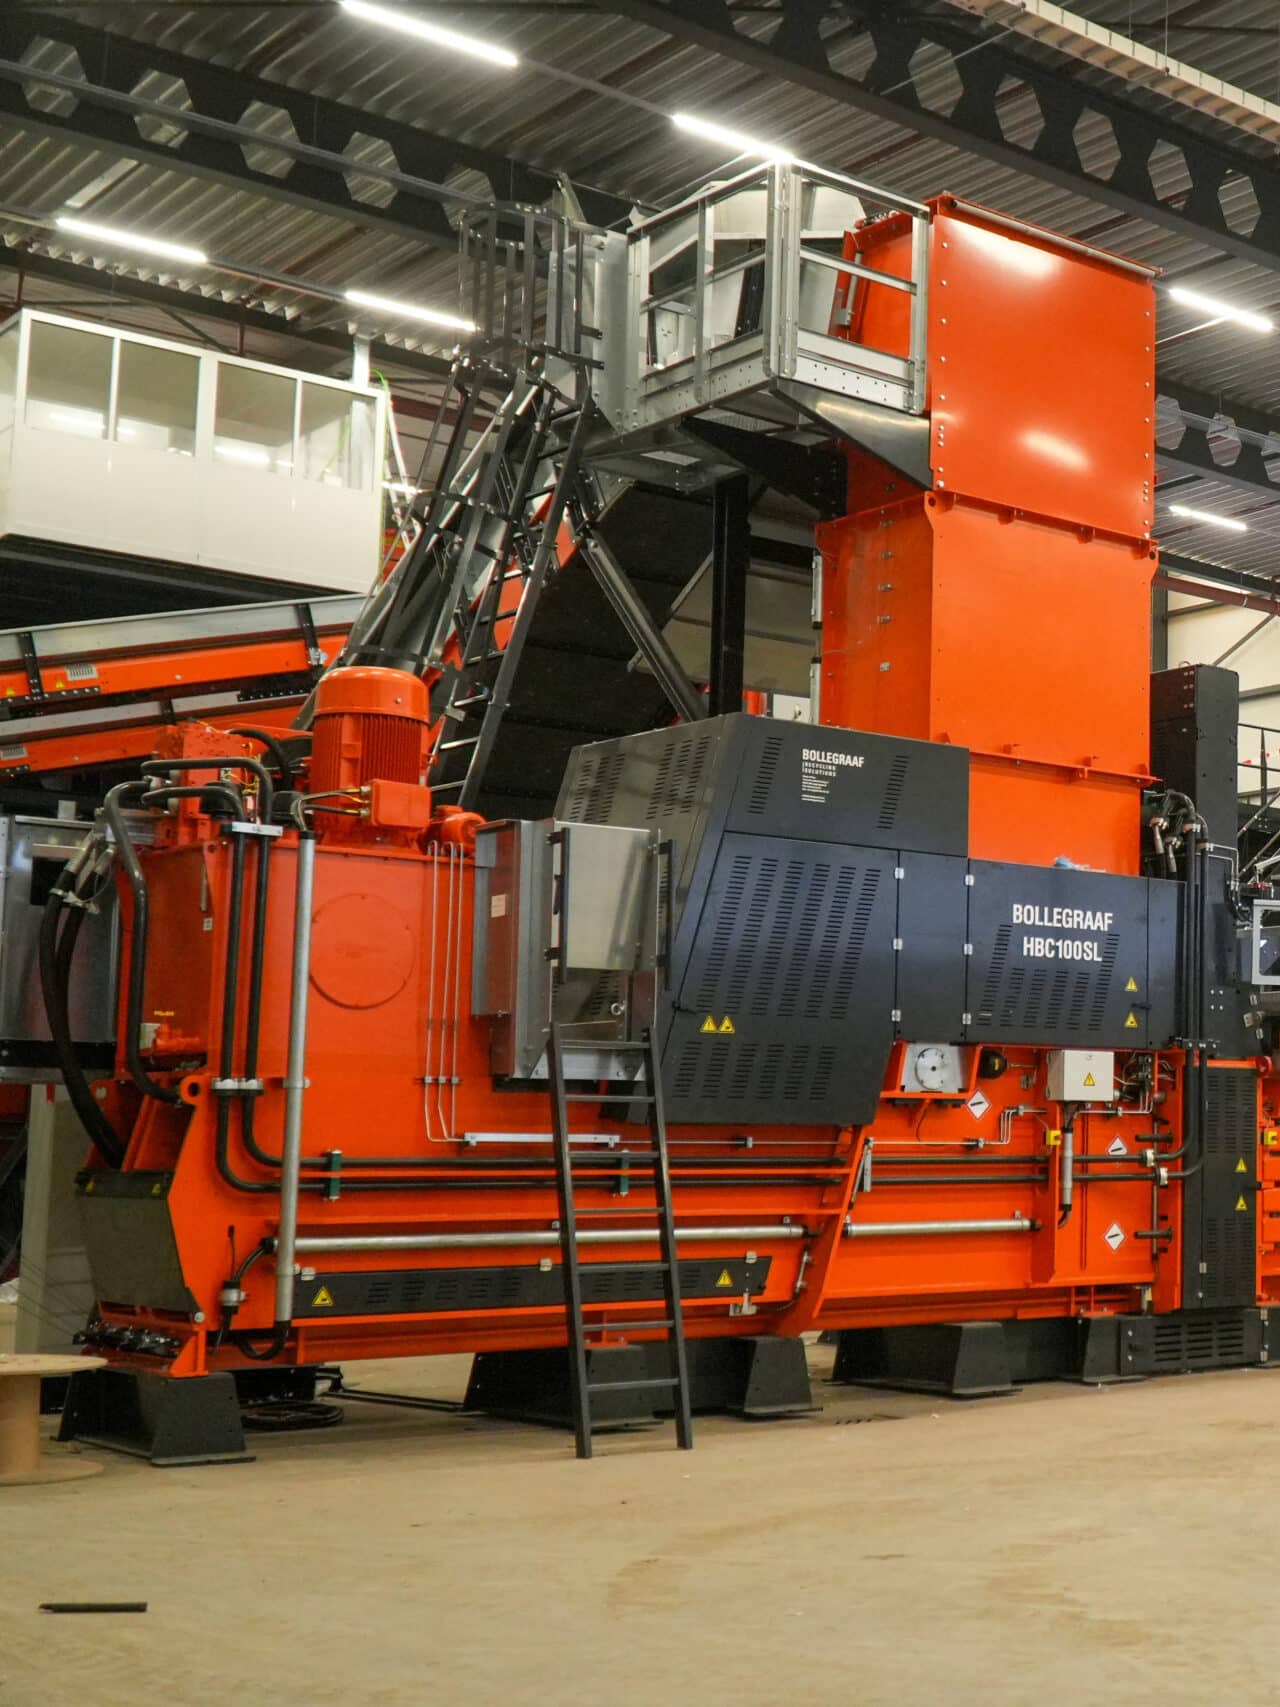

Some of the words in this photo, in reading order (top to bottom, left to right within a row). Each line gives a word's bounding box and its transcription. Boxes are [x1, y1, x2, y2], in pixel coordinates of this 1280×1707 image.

[802, 748, 865, 768] BOLLEGRAAF
[1012, 904, 1113, 932] BOLLEGRAAF
[1023, 936, 1102, 961] HBC100SL
